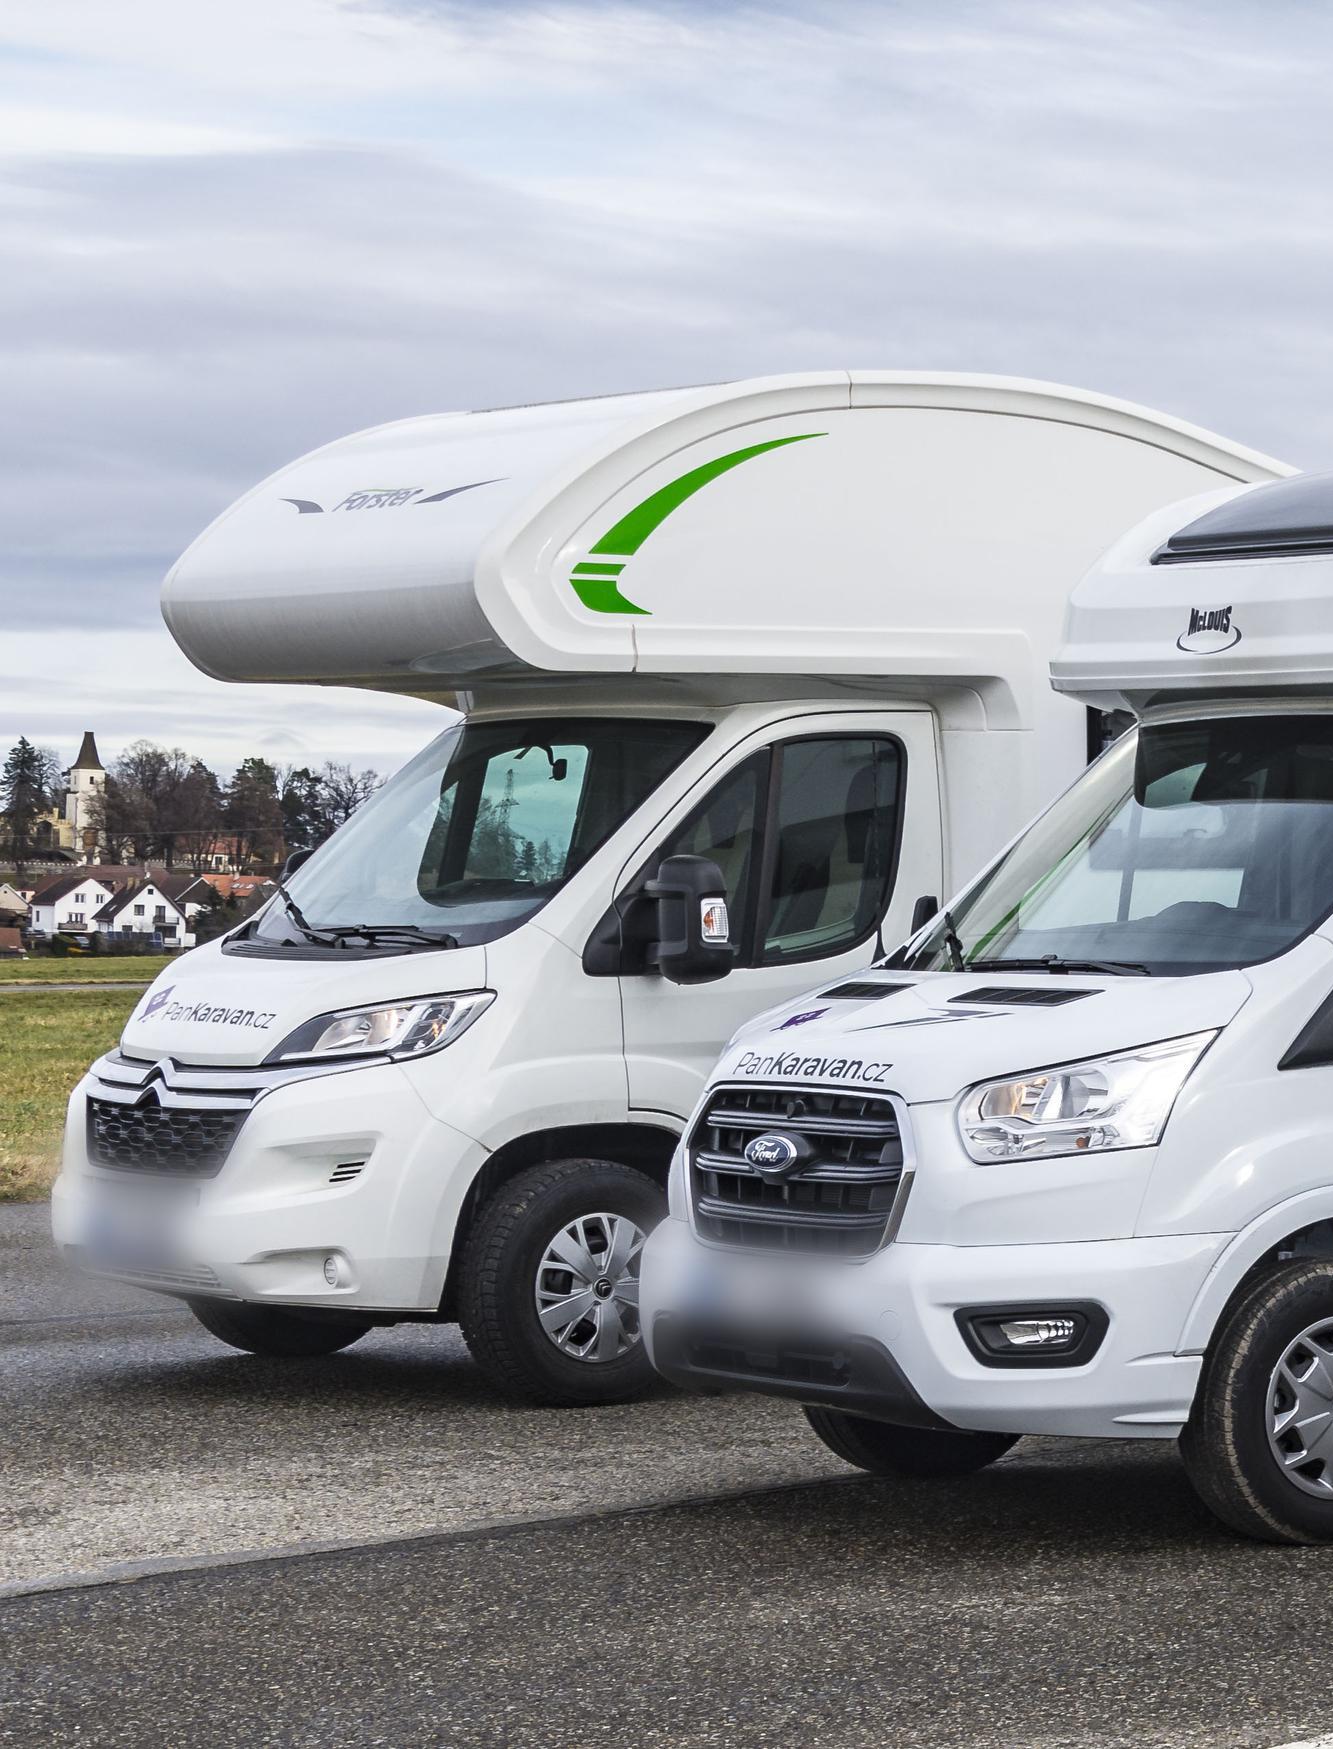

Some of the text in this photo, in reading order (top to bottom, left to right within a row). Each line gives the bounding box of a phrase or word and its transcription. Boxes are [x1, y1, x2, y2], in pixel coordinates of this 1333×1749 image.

[332, 488, 424, 512] Forster
[162, 1001, 277, 1030] PanKaravan.cz
[732, 1051, 894, 1083] PanKaravan.cz
[751, 1140, 780, 1162] Ford
